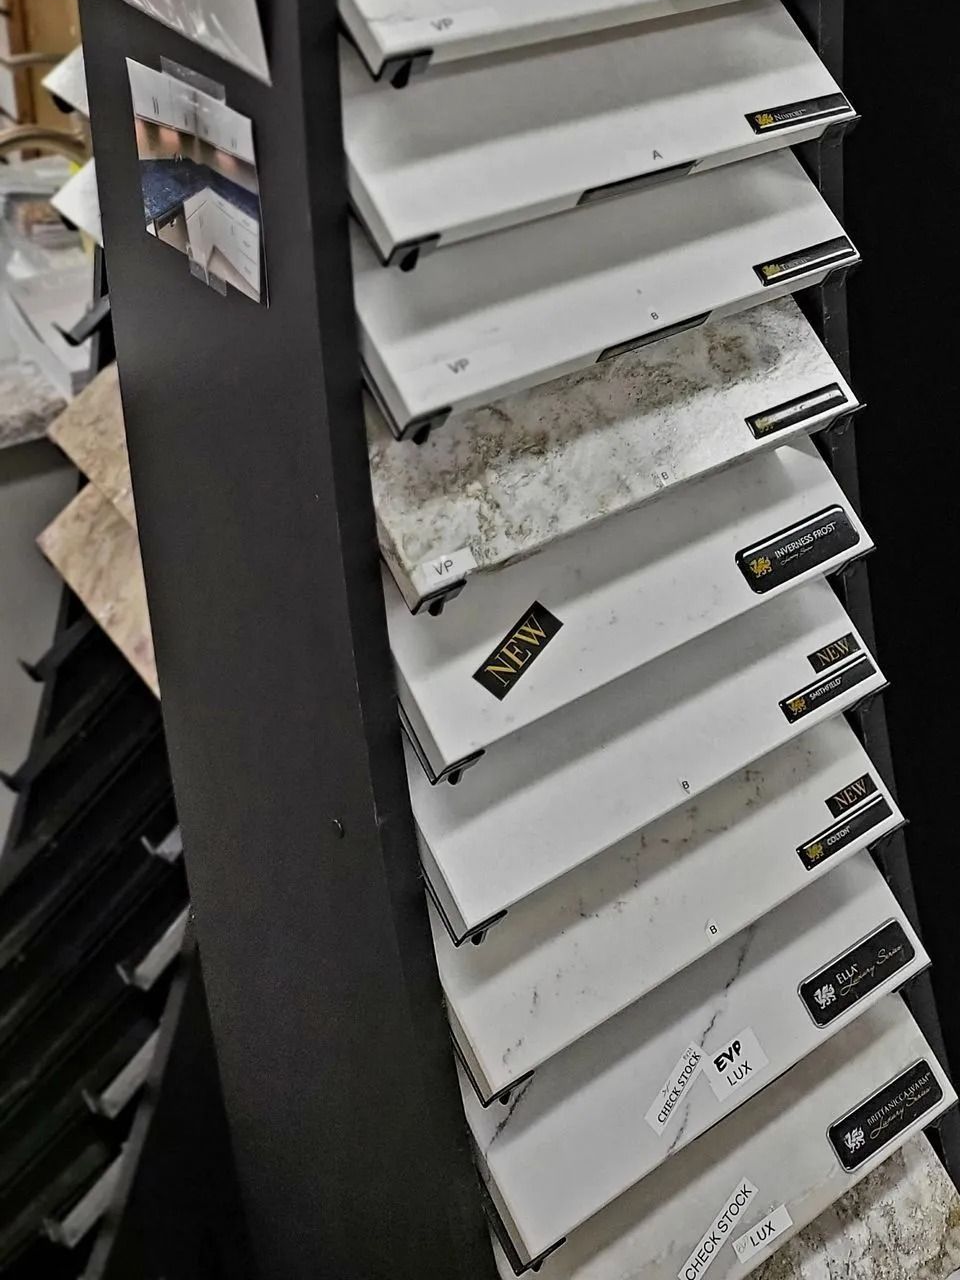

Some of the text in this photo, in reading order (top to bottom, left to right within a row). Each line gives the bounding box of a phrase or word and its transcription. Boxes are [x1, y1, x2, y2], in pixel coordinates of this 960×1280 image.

[774, 521, 837, 559] INVERNESS FROST
[433, 559, 454, 576] VP
[484, 614, 547, 688] NEW
[816, 638, 850, 666] NEW
[809, 676, 842, 701] SMITHFIELD
[834, 779, 869, 810] NEW
[826, 826, 851, 846] COLTON
[710, 925, 718, 935] B
[836, 963, 858, 985] ELLA
[713, 1039, 742, 1073] EVP
[726, 1060, 753, 1087] LUX
[657, 1086, 681, 1124] CHECK
[678, 1051, 702, 1088] STOCK
[685, 1184, 753, 1280] CHECK STOCK
[749, 1221, 776, 1248] LUX
